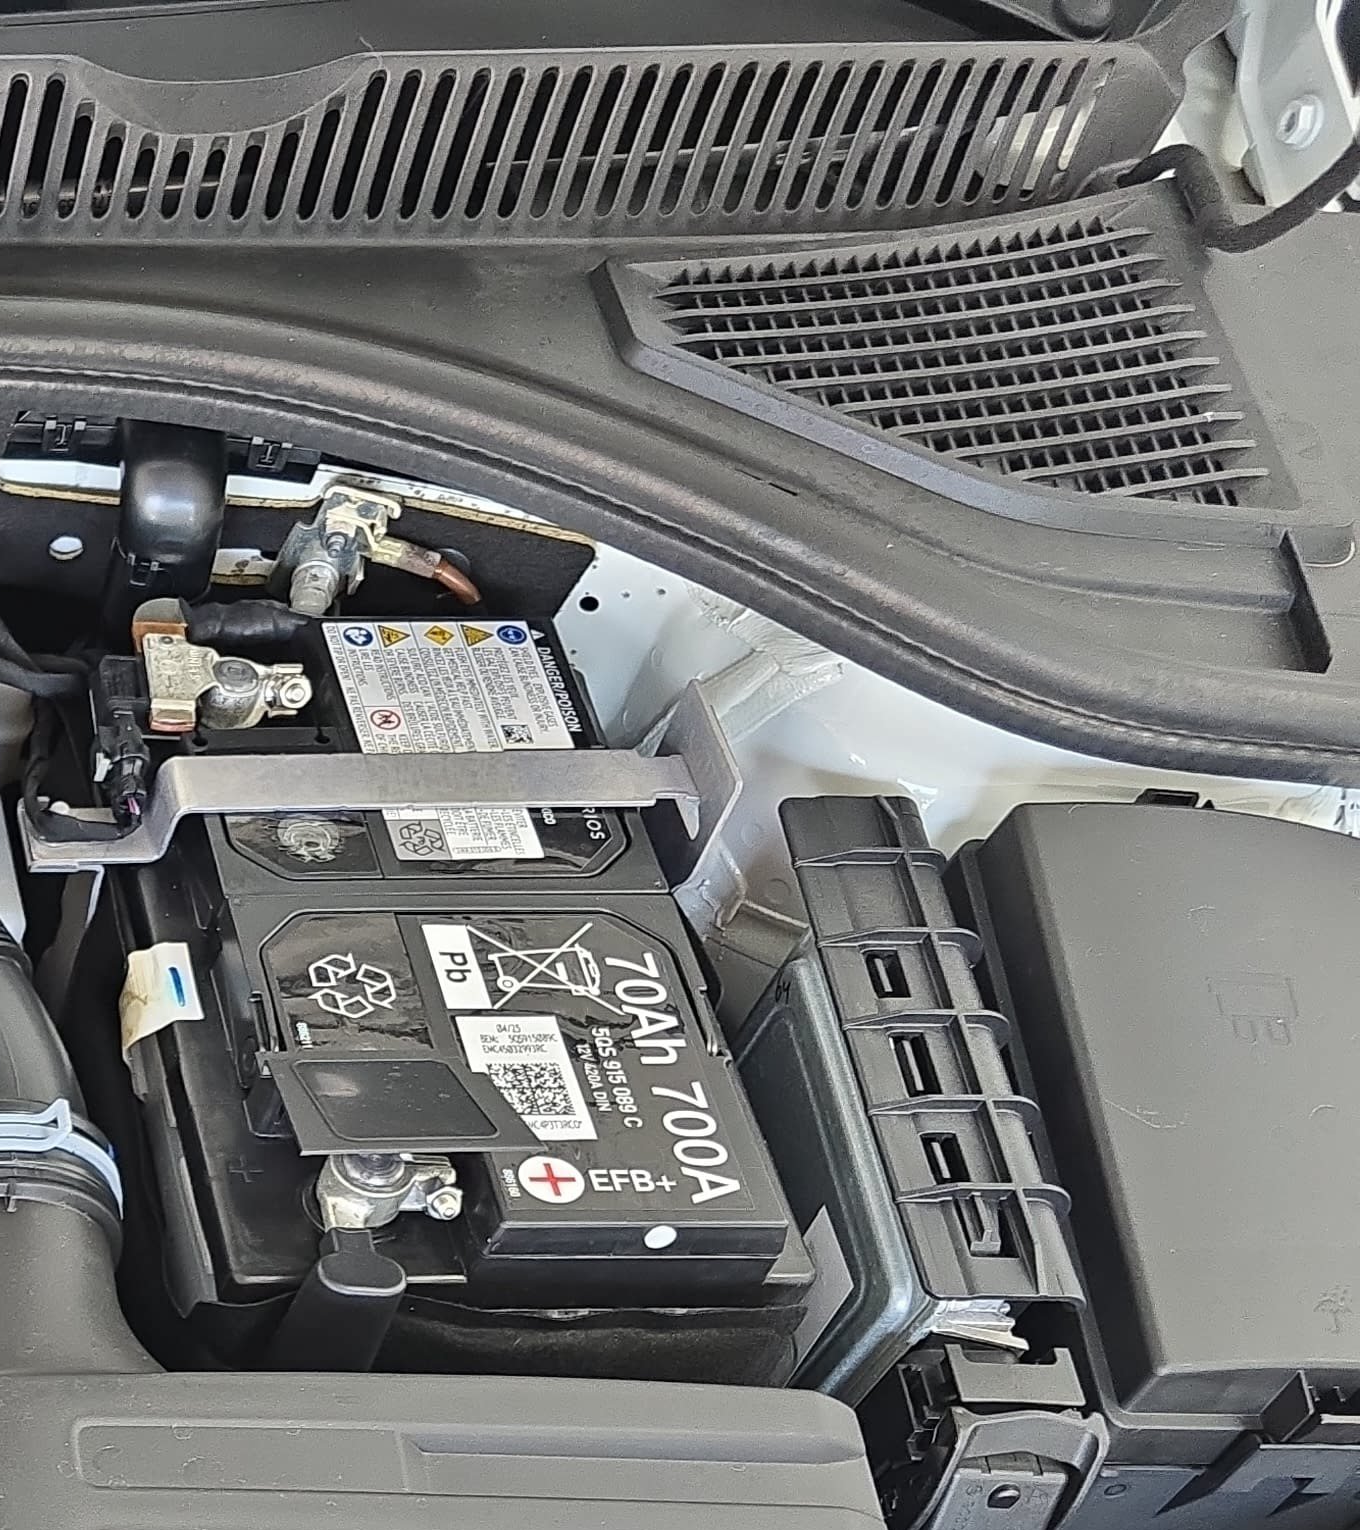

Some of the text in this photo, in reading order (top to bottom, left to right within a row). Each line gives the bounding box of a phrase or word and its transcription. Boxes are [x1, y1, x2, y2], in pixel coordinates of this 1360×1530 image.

[459, 664, 473, 677] EYES
[535, 646, 583, 732] DANGER/POISON
[528, 704, 542, 712] OR
[439, 951, 471, 983] Pb
[576, 1043, 594, 1062] 12V
[593, 1091, 613, 1112] DIN
[605, 1057, 624, 1086] 915
[605, 952, 740, 1204] 70Ah 700A
[616, 1087, 638, 1120] 089
[624, 1117, 643, 1129] C
[588, 1169, 677, 1192] EFB+
